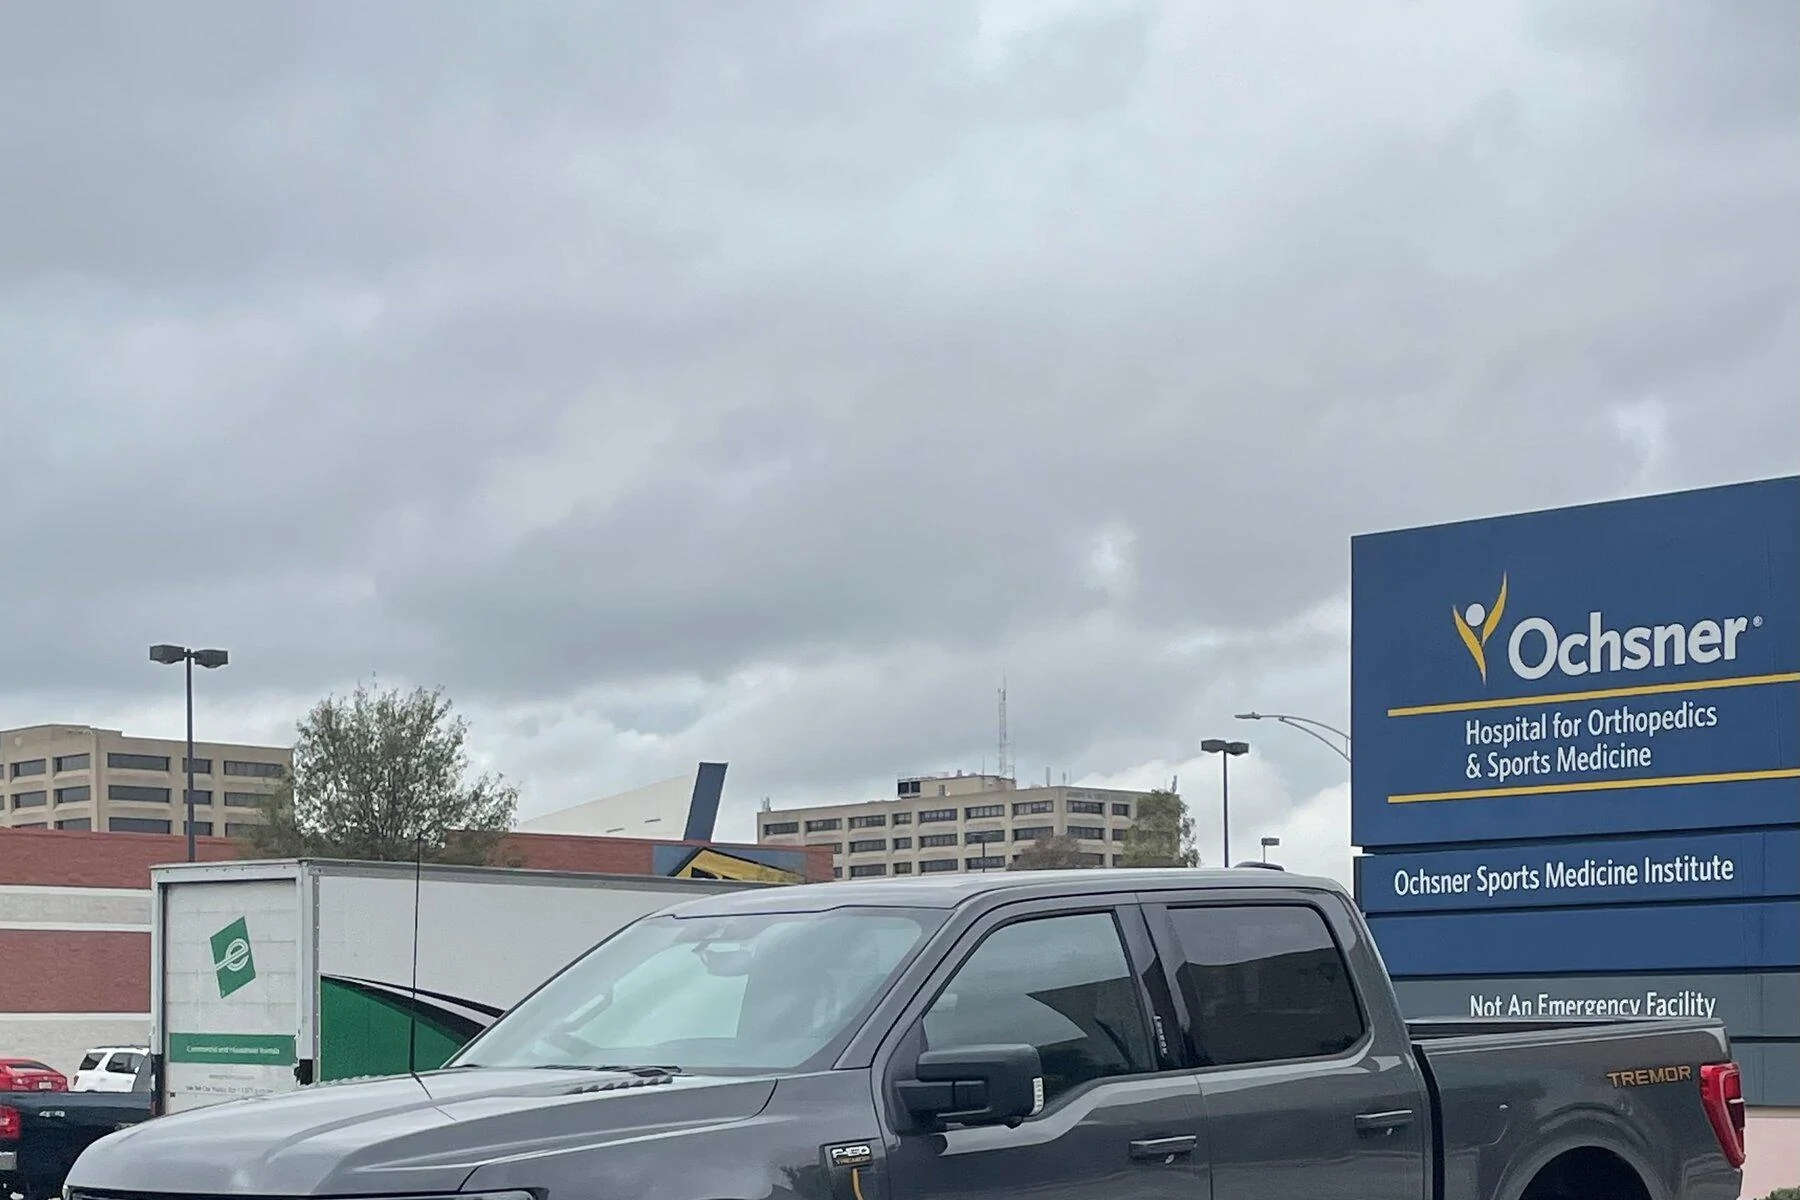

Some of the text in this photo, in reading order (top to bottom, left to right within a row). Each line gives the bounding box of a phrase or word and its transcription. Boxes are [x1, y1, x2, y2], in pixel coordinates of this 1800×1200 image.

[1508, 611, 1748, 680] Ochsner
[1465, 701, 1718, 748] Hospital for Orthopedics
[1465, 742, 1652, 782] & Sports Medicine
[1394, 854, 1734, 896] Ochsner Sports Medicine Institute
[1470, 990, 1716, 1019] Not An Emergency Facility
[1606, 1065, 1692, 1088] TREMOR
